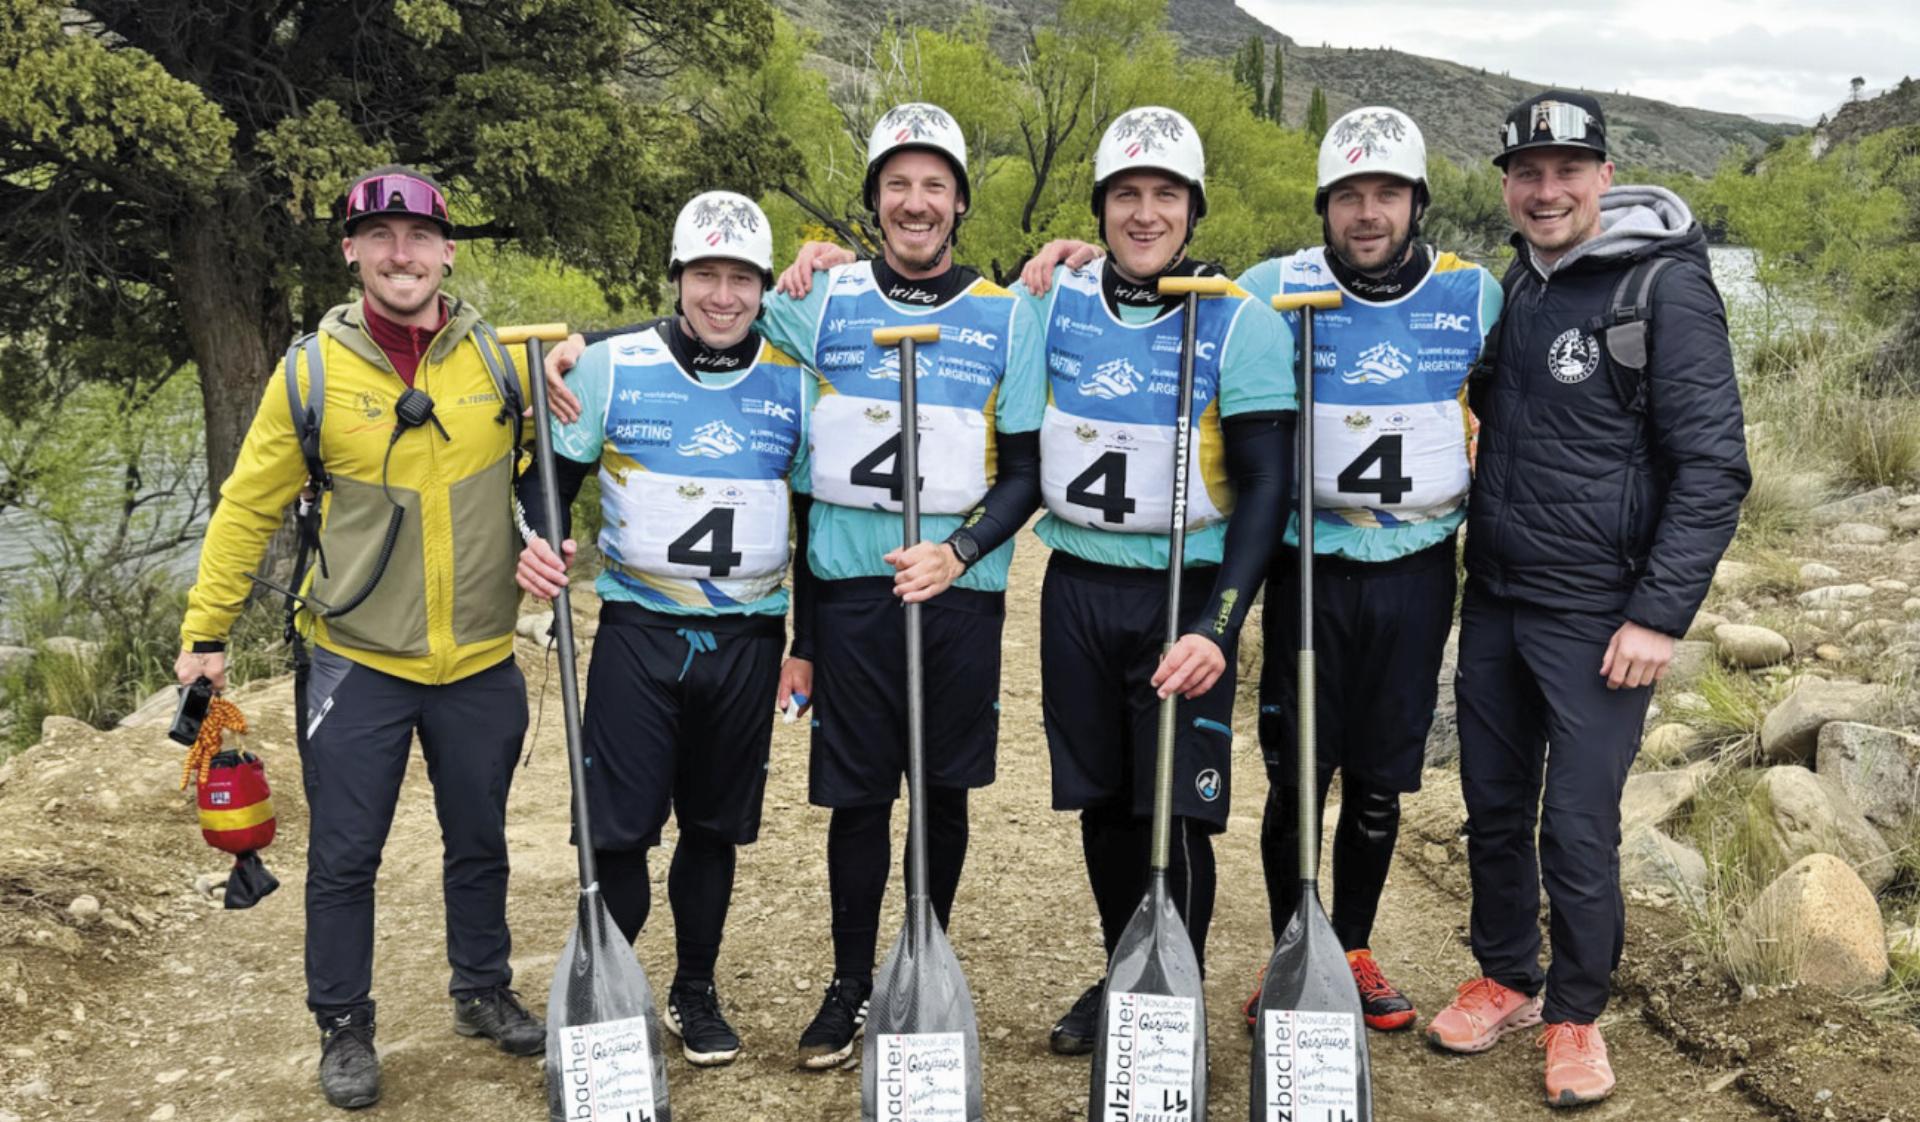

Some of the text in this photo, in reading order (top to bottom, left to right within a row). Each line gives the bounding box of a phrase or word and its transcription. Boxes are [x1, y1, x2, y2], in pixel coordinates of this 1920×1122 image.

[960, 327, 998, 350] FAC
[1434, 312, 1471, 332] FAC
[823, 350, 865, 366] RAFTING
[937, 367, 992, 386] ARGENTINA
[1050, 352, 1082, 377] RAFTING
[616, 424, 673, 441] RAFTING
[764, 399, 797, 424] FAC
[850, 430, 924, 501] 4
[1066, 451, 1136, 524] 4
[1173, 416, 1188, 529] panenka
[1338, 434, 1412, 504] 4
[668, 507, 742, 577] 4
[565, 1027, 593, 1122] bacher.
[879, 1035, 904, 1122] acher.
